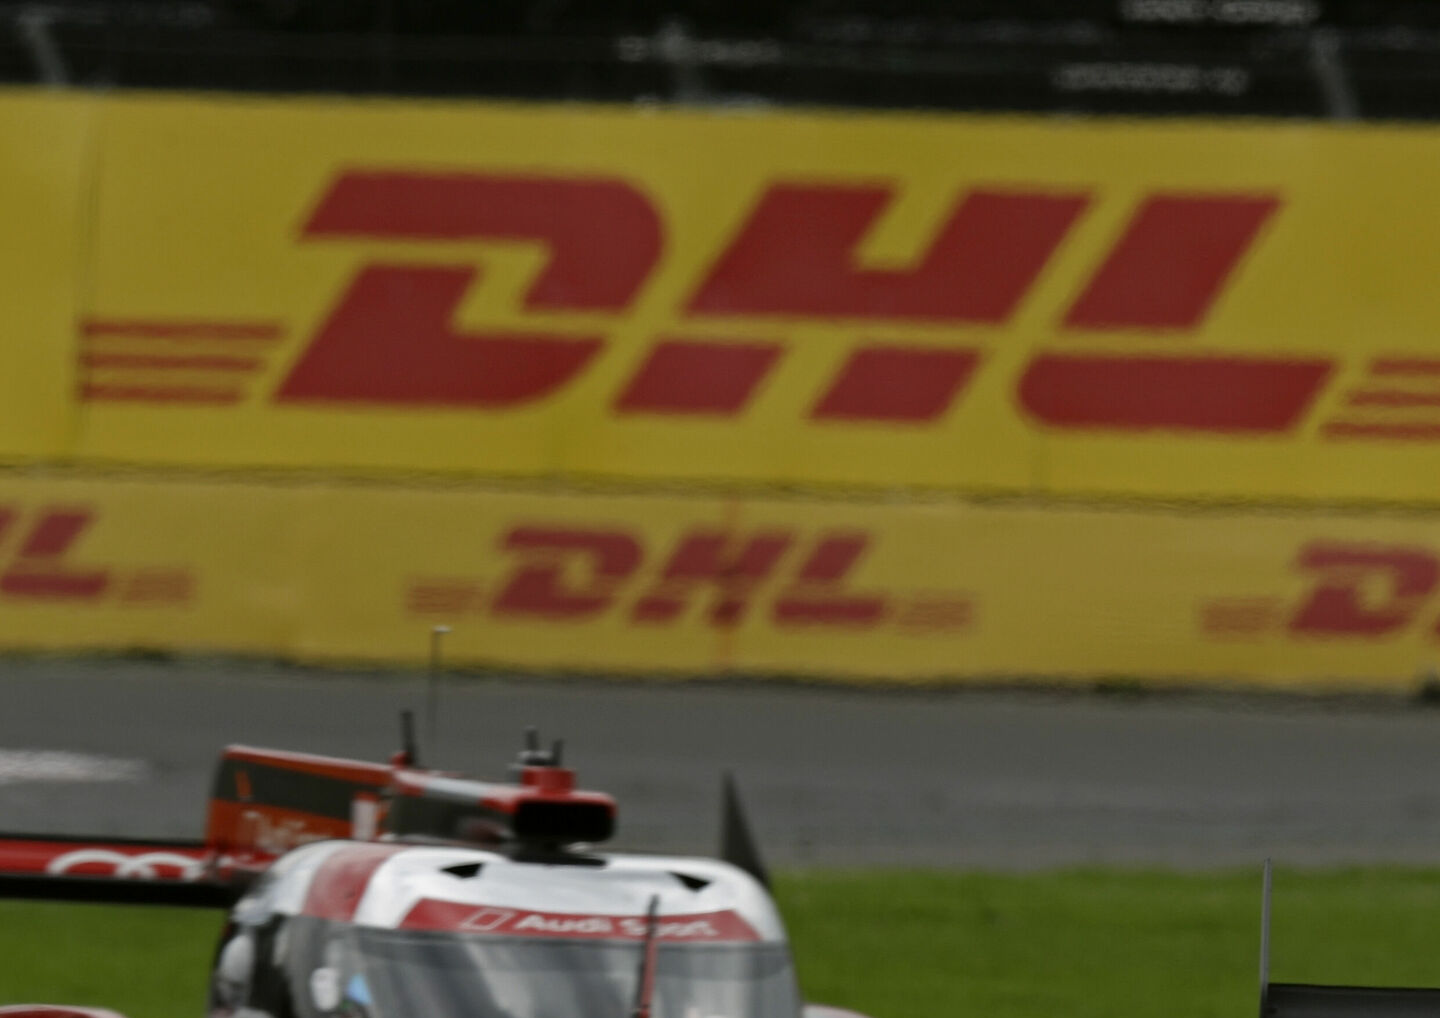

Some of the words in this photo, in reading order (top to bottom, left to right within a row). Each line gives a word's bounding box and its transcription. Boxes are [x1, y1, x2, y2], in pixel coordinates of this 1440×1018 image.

[271, 167, 1337, 437] DHL
[489, 526, 890, 628] DHL
[514, 915, 613, 934] Audi
